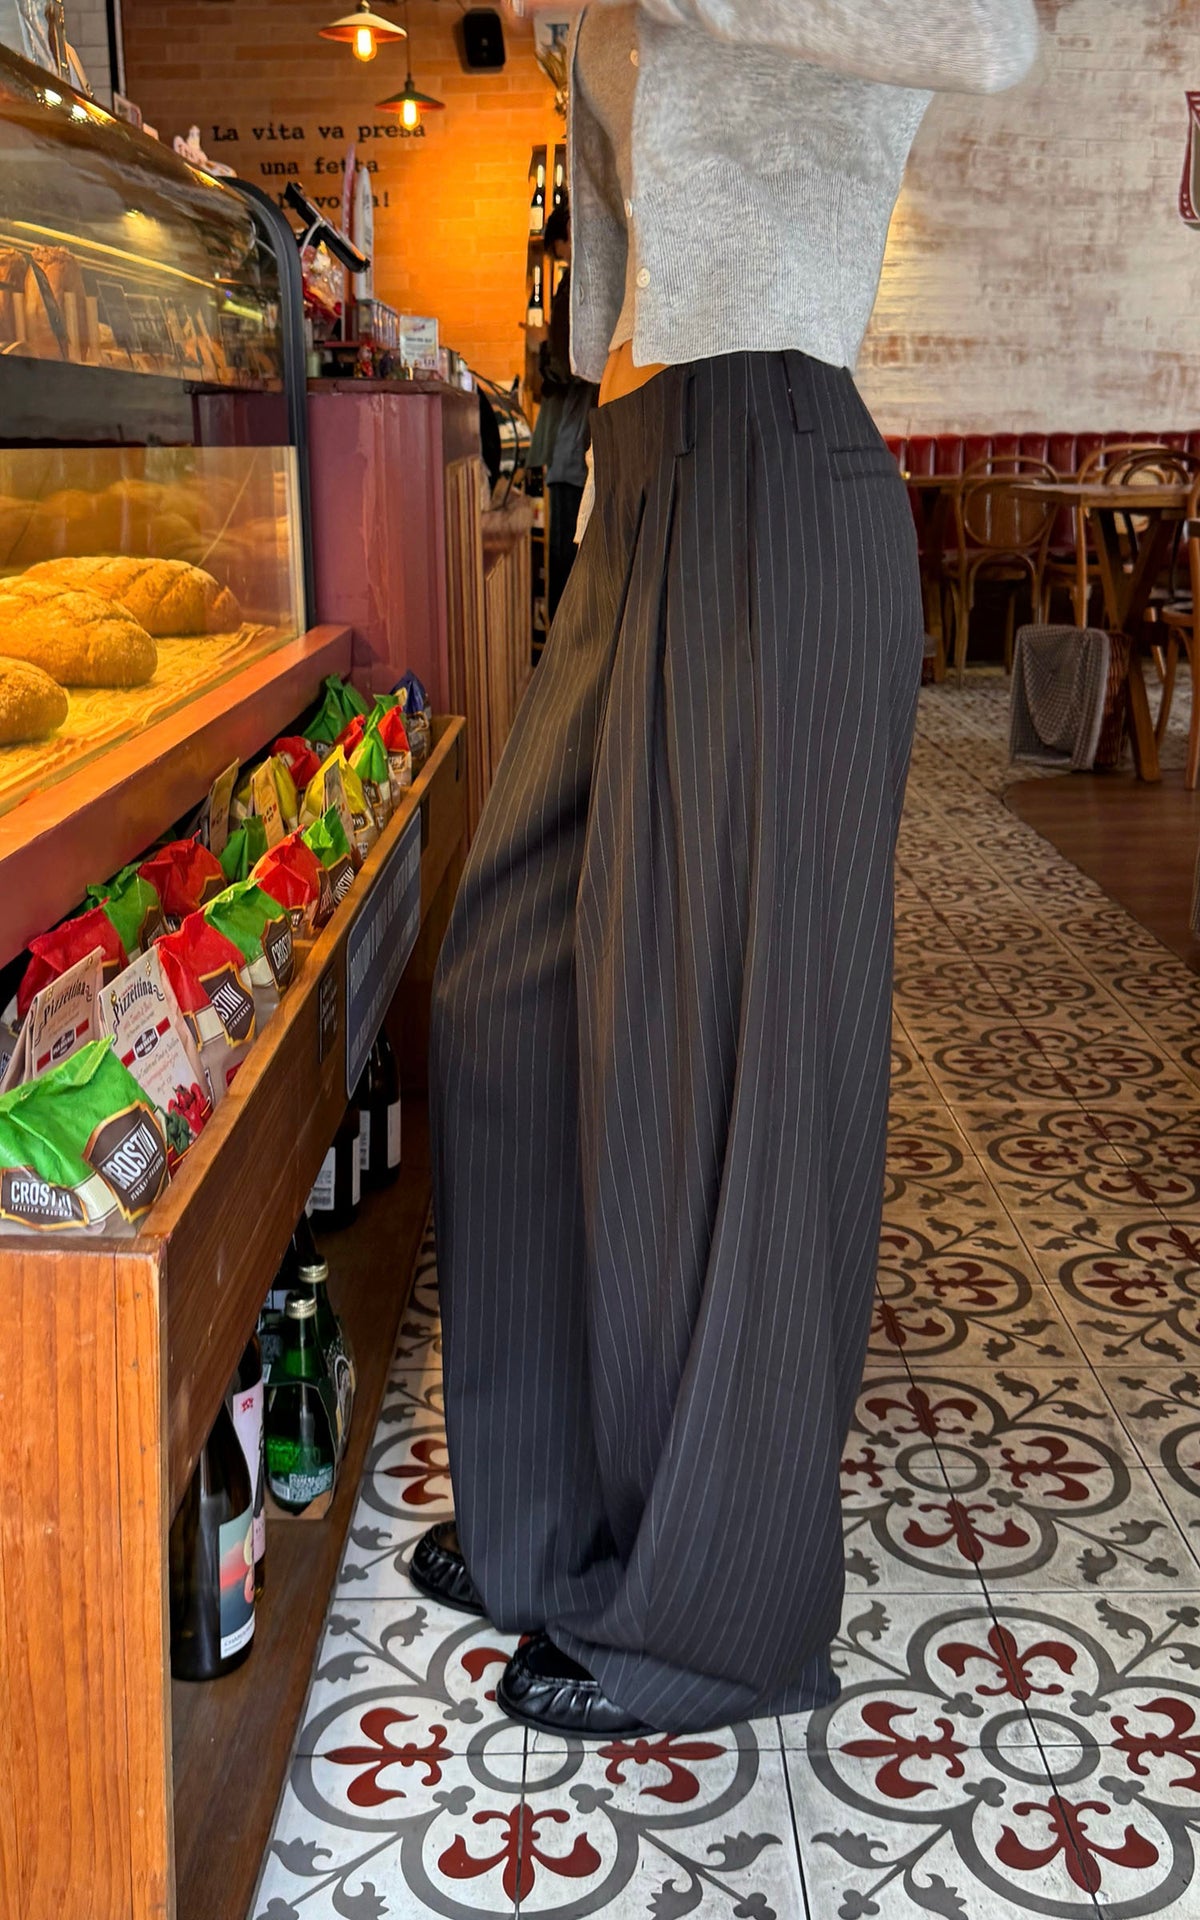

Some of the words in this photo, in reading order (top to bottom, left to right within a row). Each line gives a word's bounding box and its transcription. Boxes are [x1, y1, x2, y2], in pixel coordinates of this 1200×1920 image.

[212, 126, 239, 141] La
[252, 123, 304, 141] vita
[318, 126, 344, 139] va
[260, 161, 299, 176] una
[113, 977, 153, 1025] Pizzettina
